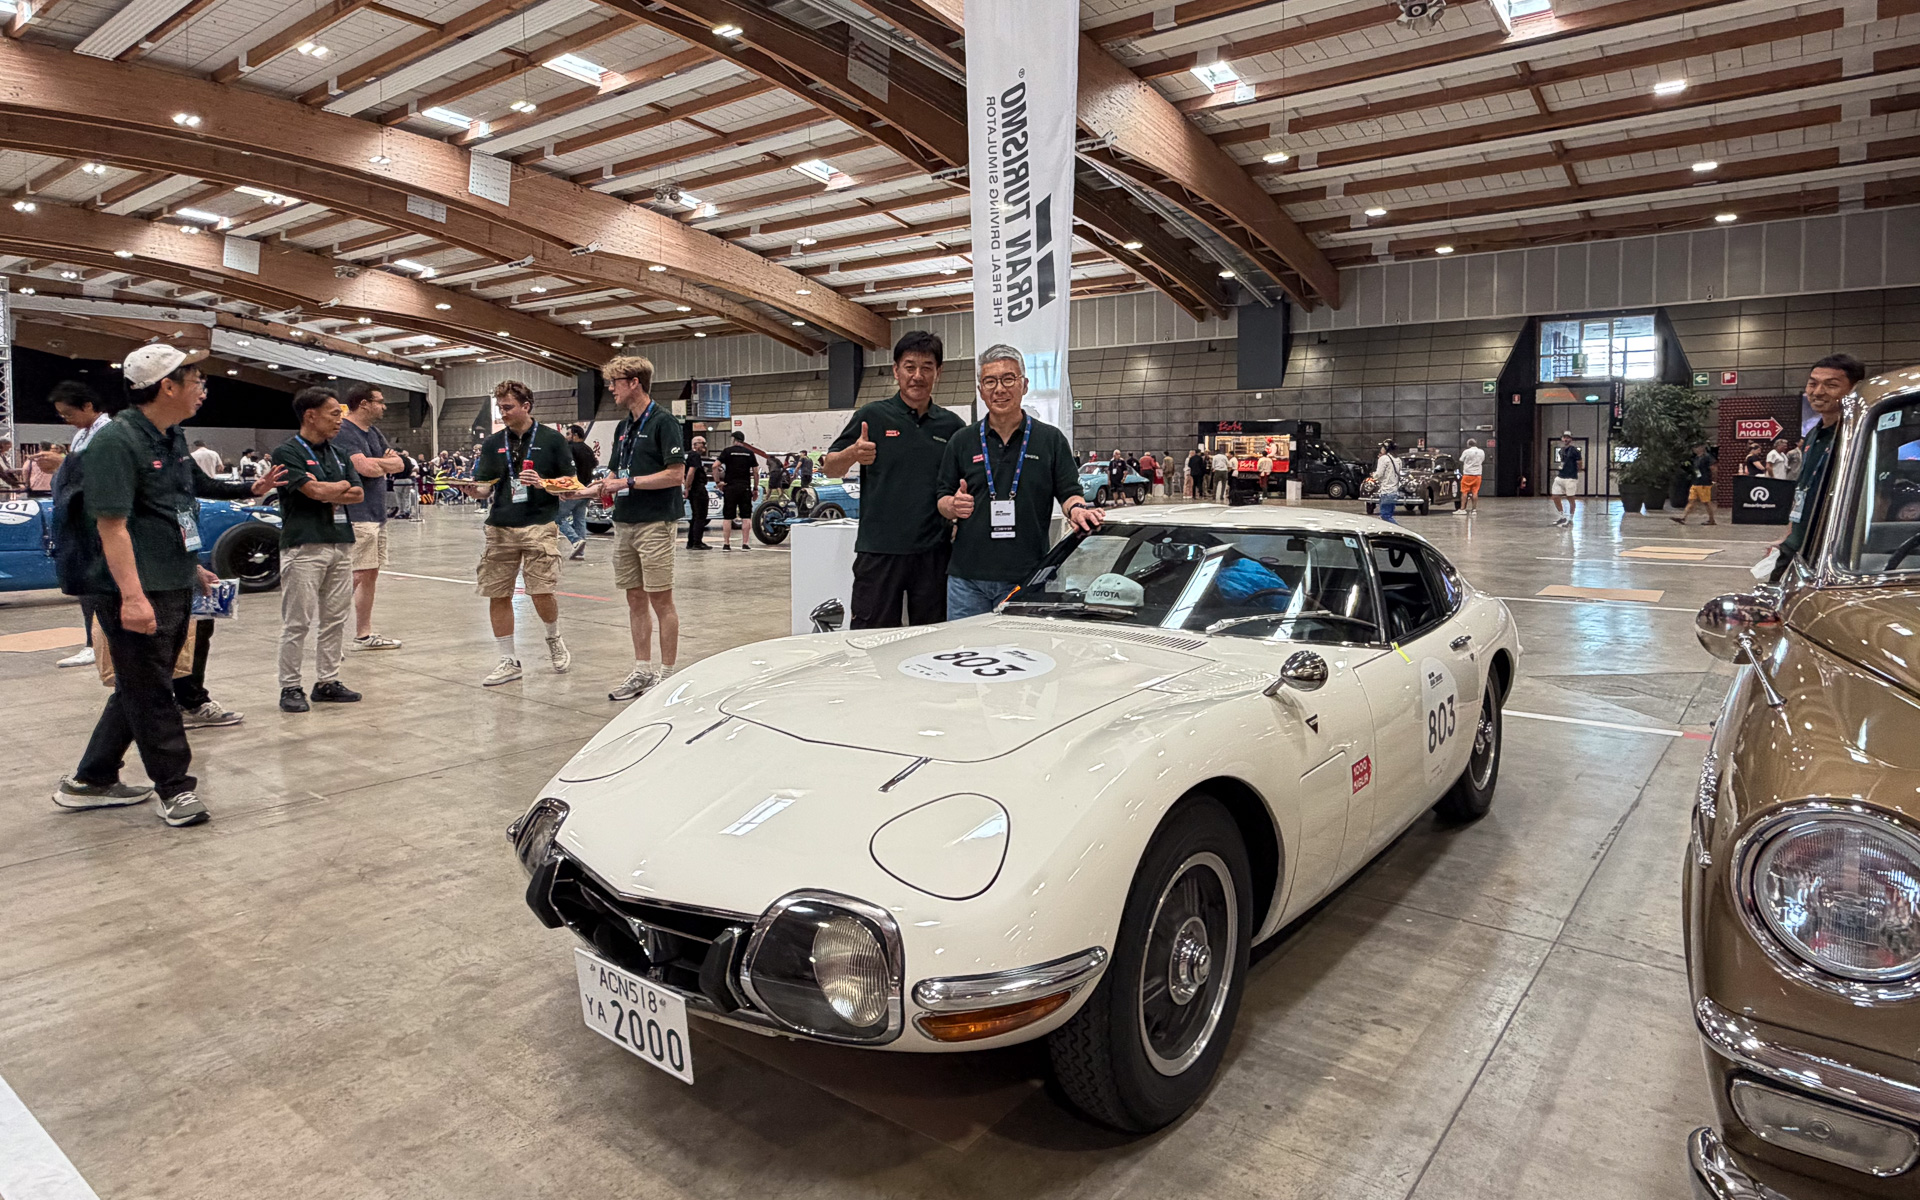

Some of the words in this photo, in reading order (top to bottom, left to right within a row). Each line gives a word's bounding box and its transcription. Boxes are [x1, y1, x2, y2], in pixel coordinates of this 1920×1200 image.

[1741, 421, 1770, 429] 1000
[1887, 413, 1897, 423] 4
[1739, 429, 1773, 437] MIGLIA
[1092, 590, 1121, 599] TOYOTA
[932, 651, 1027, 677] 803
[1428, 693, 1456, 754] 803
[1353, 759, 1368, 776] 1000
[1353, 773, 1369, 791] MIGLIA
[599, 966, 658, 1014] ACN518
[584, 993, 608, 1024] YA
[610, 999, 685, 1072] 2000
